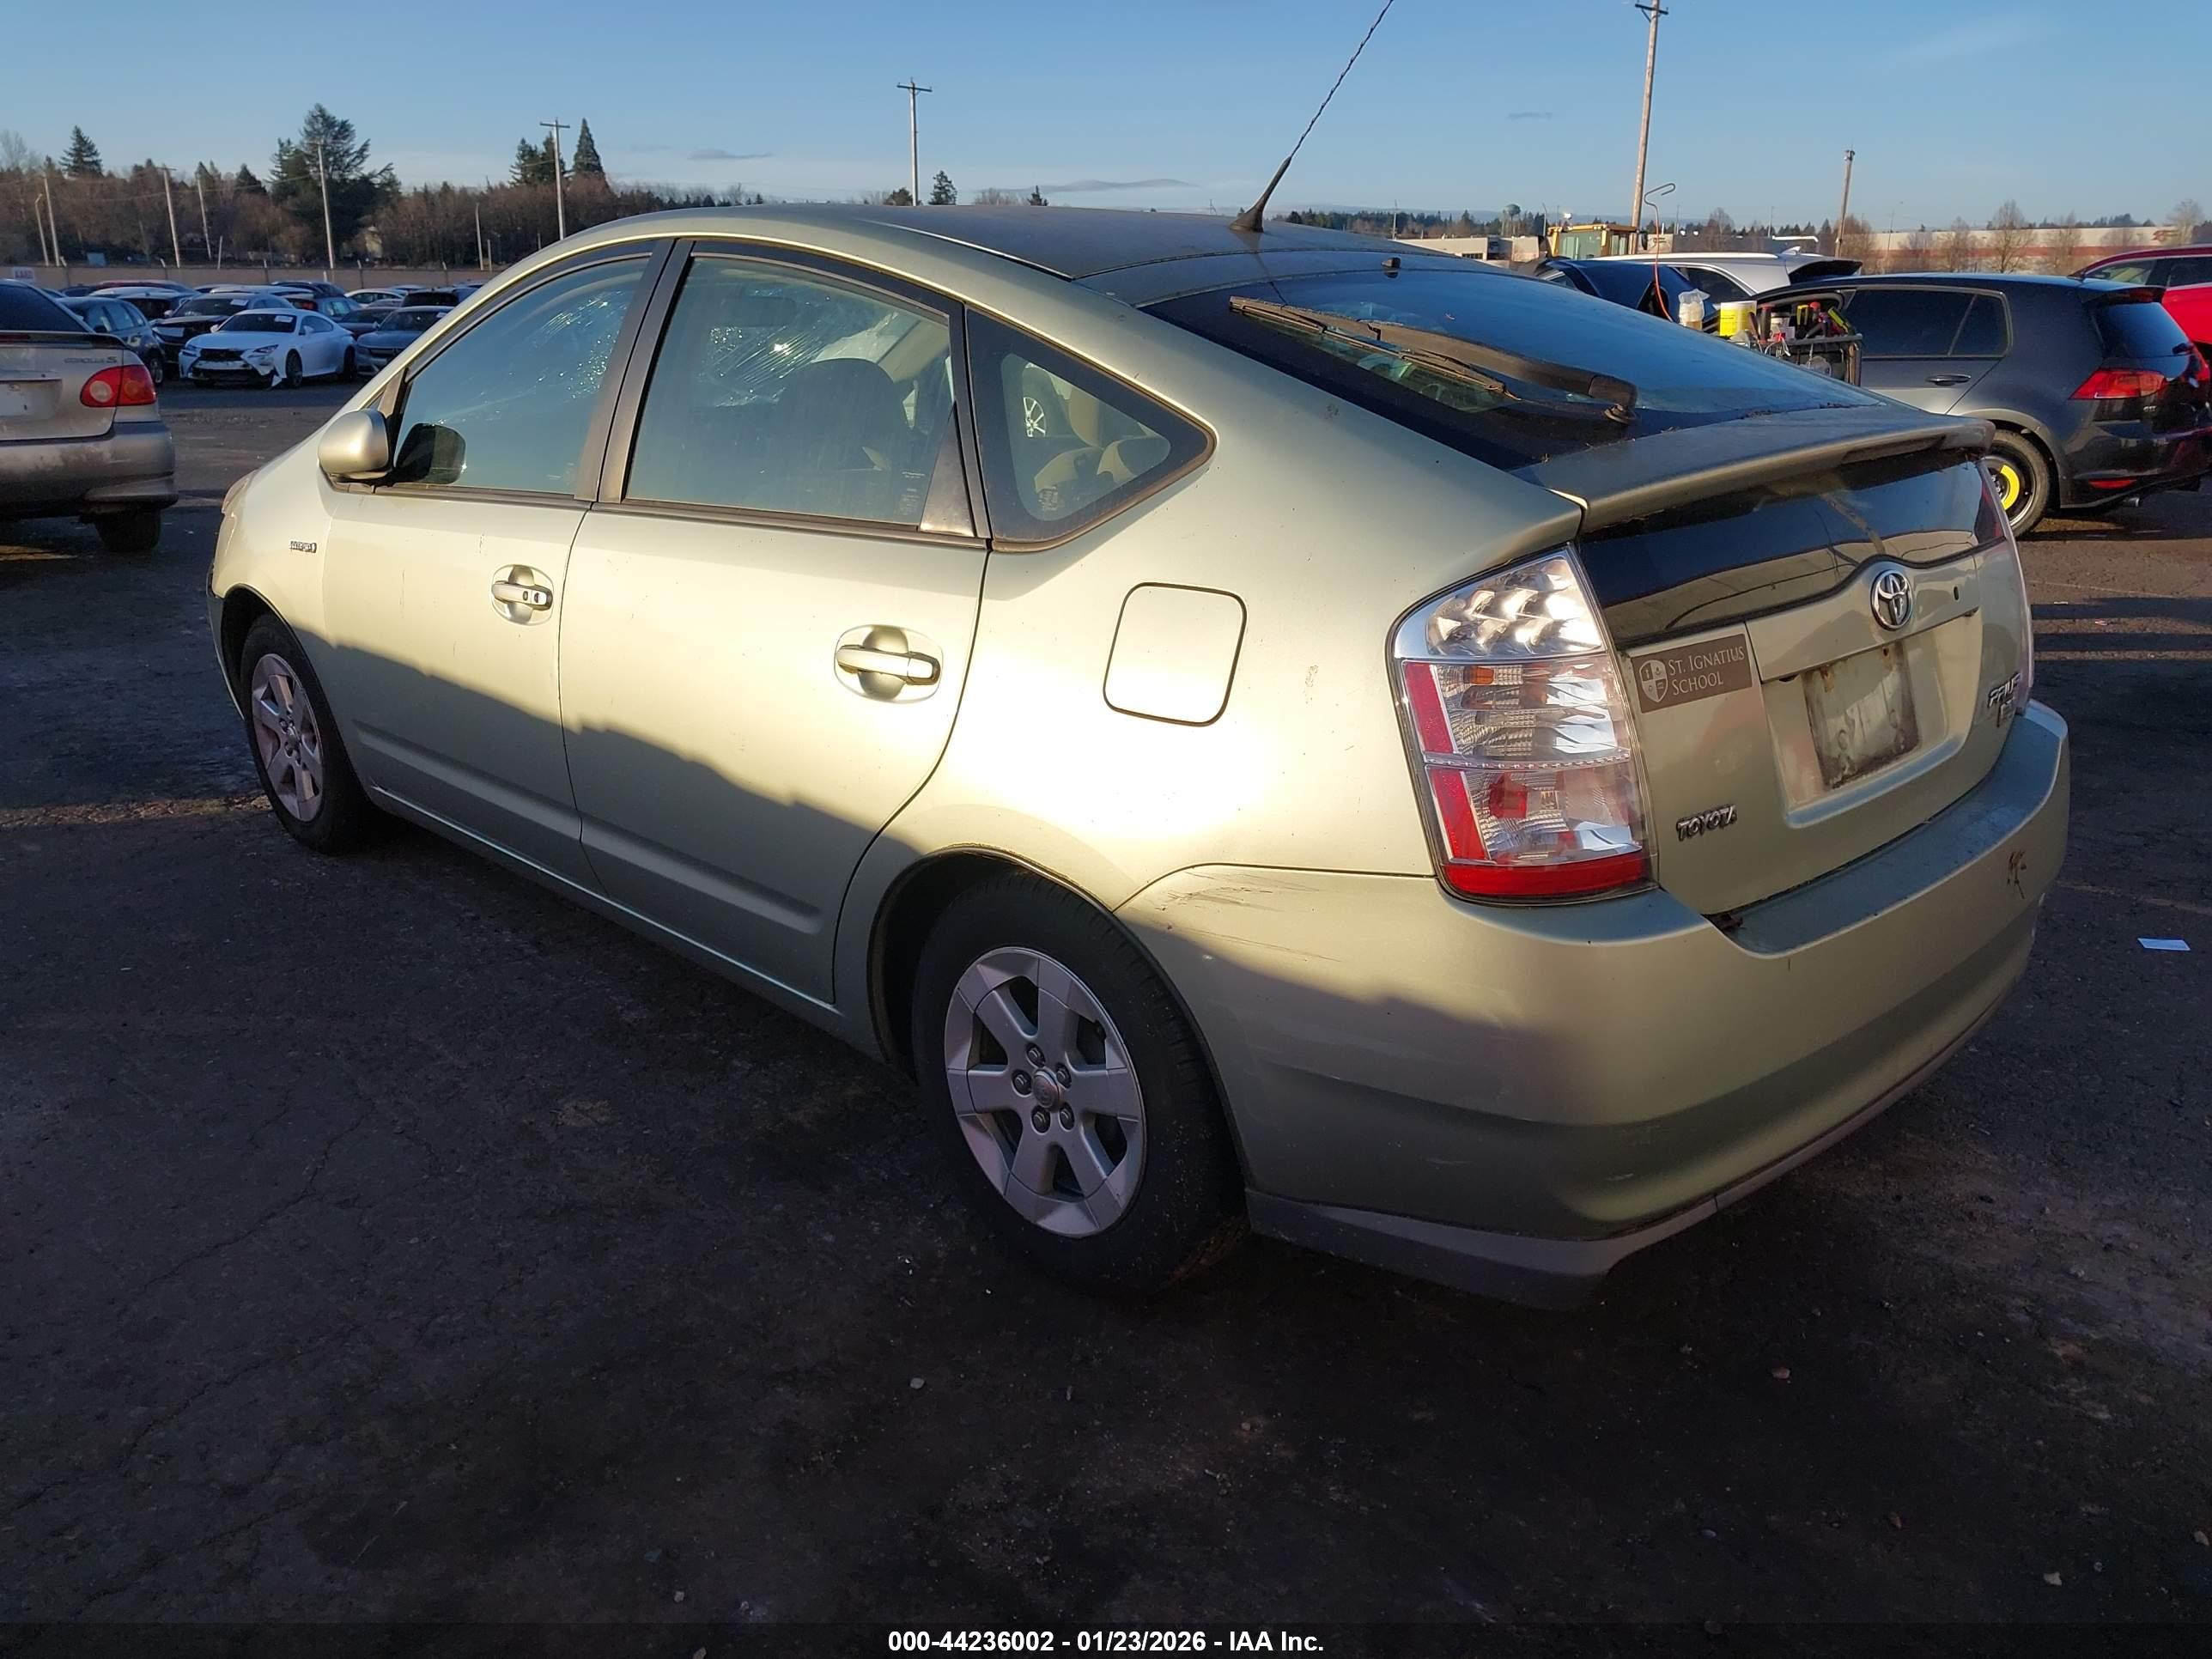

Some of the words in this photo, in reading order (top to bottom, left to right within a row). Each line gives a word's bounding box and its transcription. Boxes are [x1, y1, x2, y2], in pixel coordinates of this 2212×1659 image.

[1688, 646, 1745, 672] IGNATIUS
[1671, 671, 1724, 696] SCHOOL
[1676, 805, 1737, 842] TOYOTA
